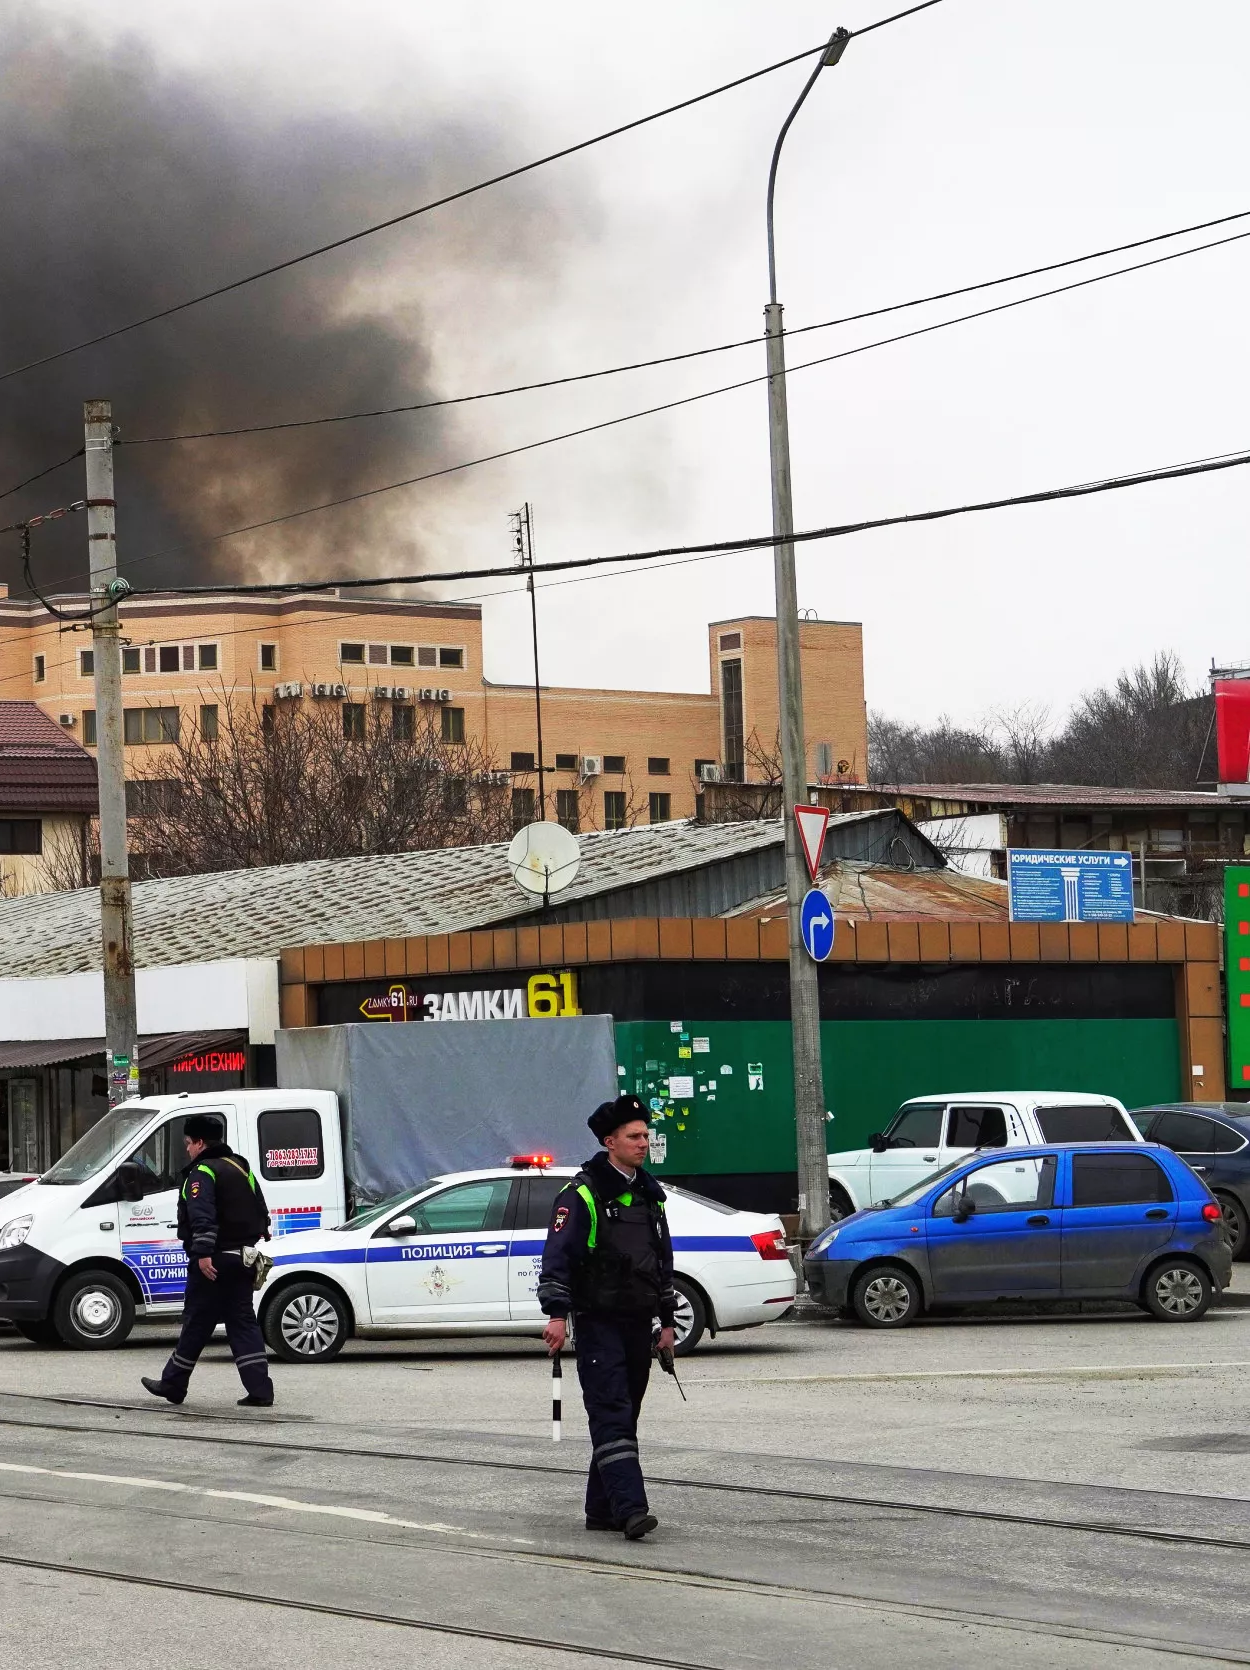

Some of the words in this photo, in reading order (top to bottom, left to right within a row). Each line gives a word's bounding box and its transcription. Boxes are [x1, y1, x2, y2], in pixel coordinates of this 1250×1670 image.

[1011, 854, 1077, 864] ЮРИДИЧЕСКИЕ
[1078, 855, 1111, 865] УСЛУГИ
[423, 988, 526, 1022] ЗАМКИ
[527, 972, 582, 1018] 61
[267, 1160, 296, 1168] ГОРЯЧАЯ
[402, 1245, 474, 1259] ПОЛИЦИЯ
